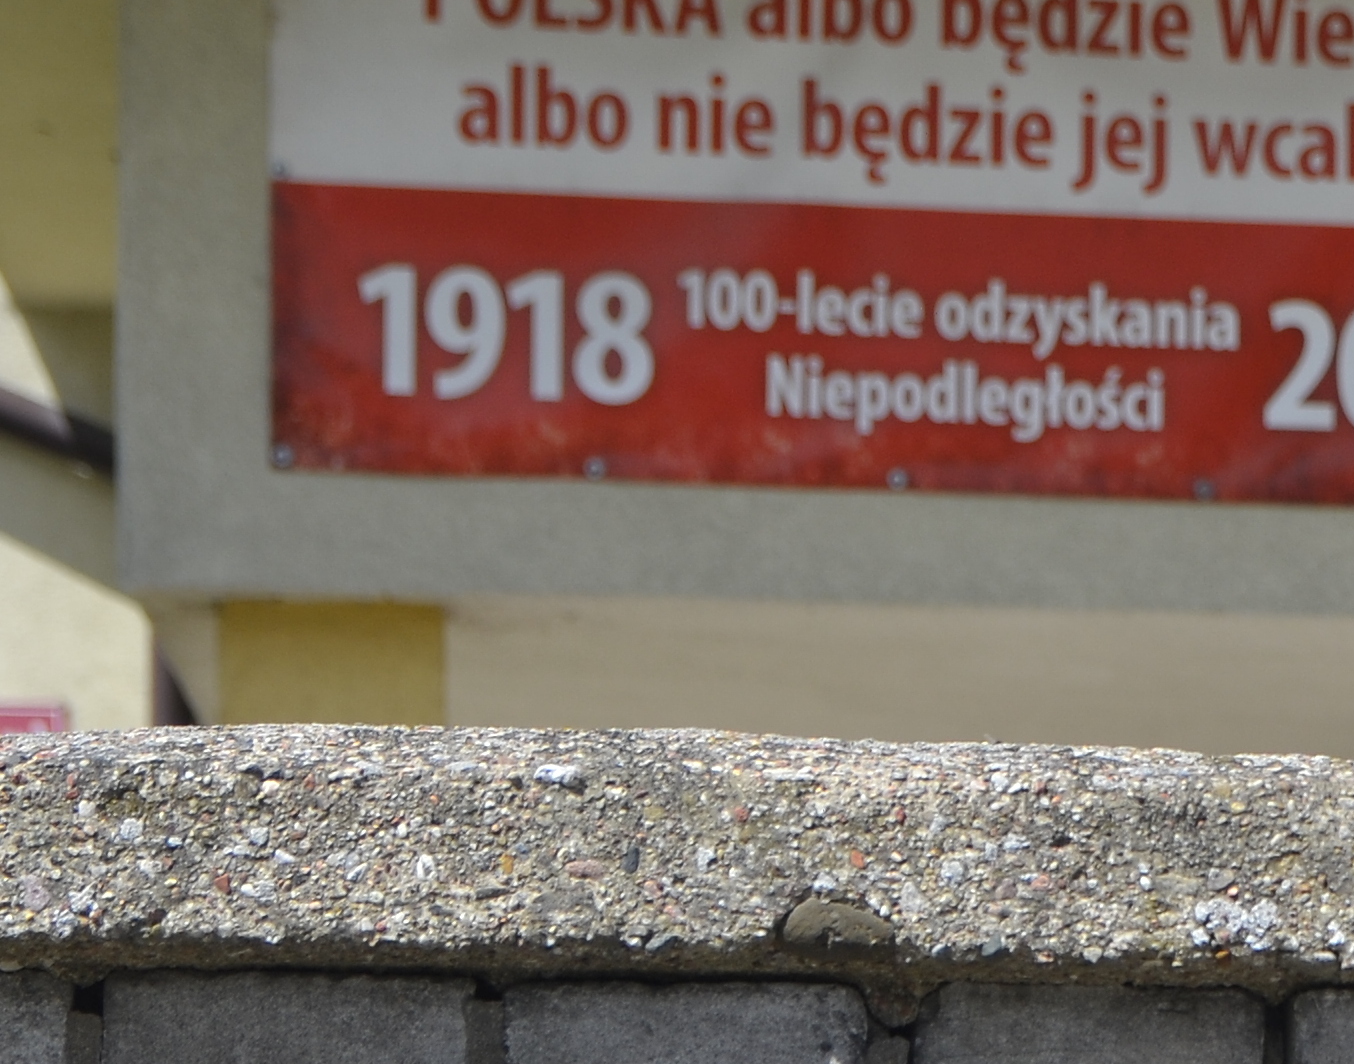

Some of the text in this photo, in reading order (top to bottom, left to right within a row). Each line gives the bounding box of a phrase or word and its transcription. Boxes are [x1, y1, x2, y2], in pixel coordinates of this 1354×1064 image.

[940, 0, 1192, 74] będzie
[458, 63, 630, 149] albo
[657, 73, 775, 157] nie
[802, 79, 1055, 184] będzie
[1072, 90, 1168, 193] jej
[358, 262, 656, 406] 1918
[676, 266, 1242, 358] 100-lecie odzyskania
[766, 353, 1166, 444] Niepodległości
